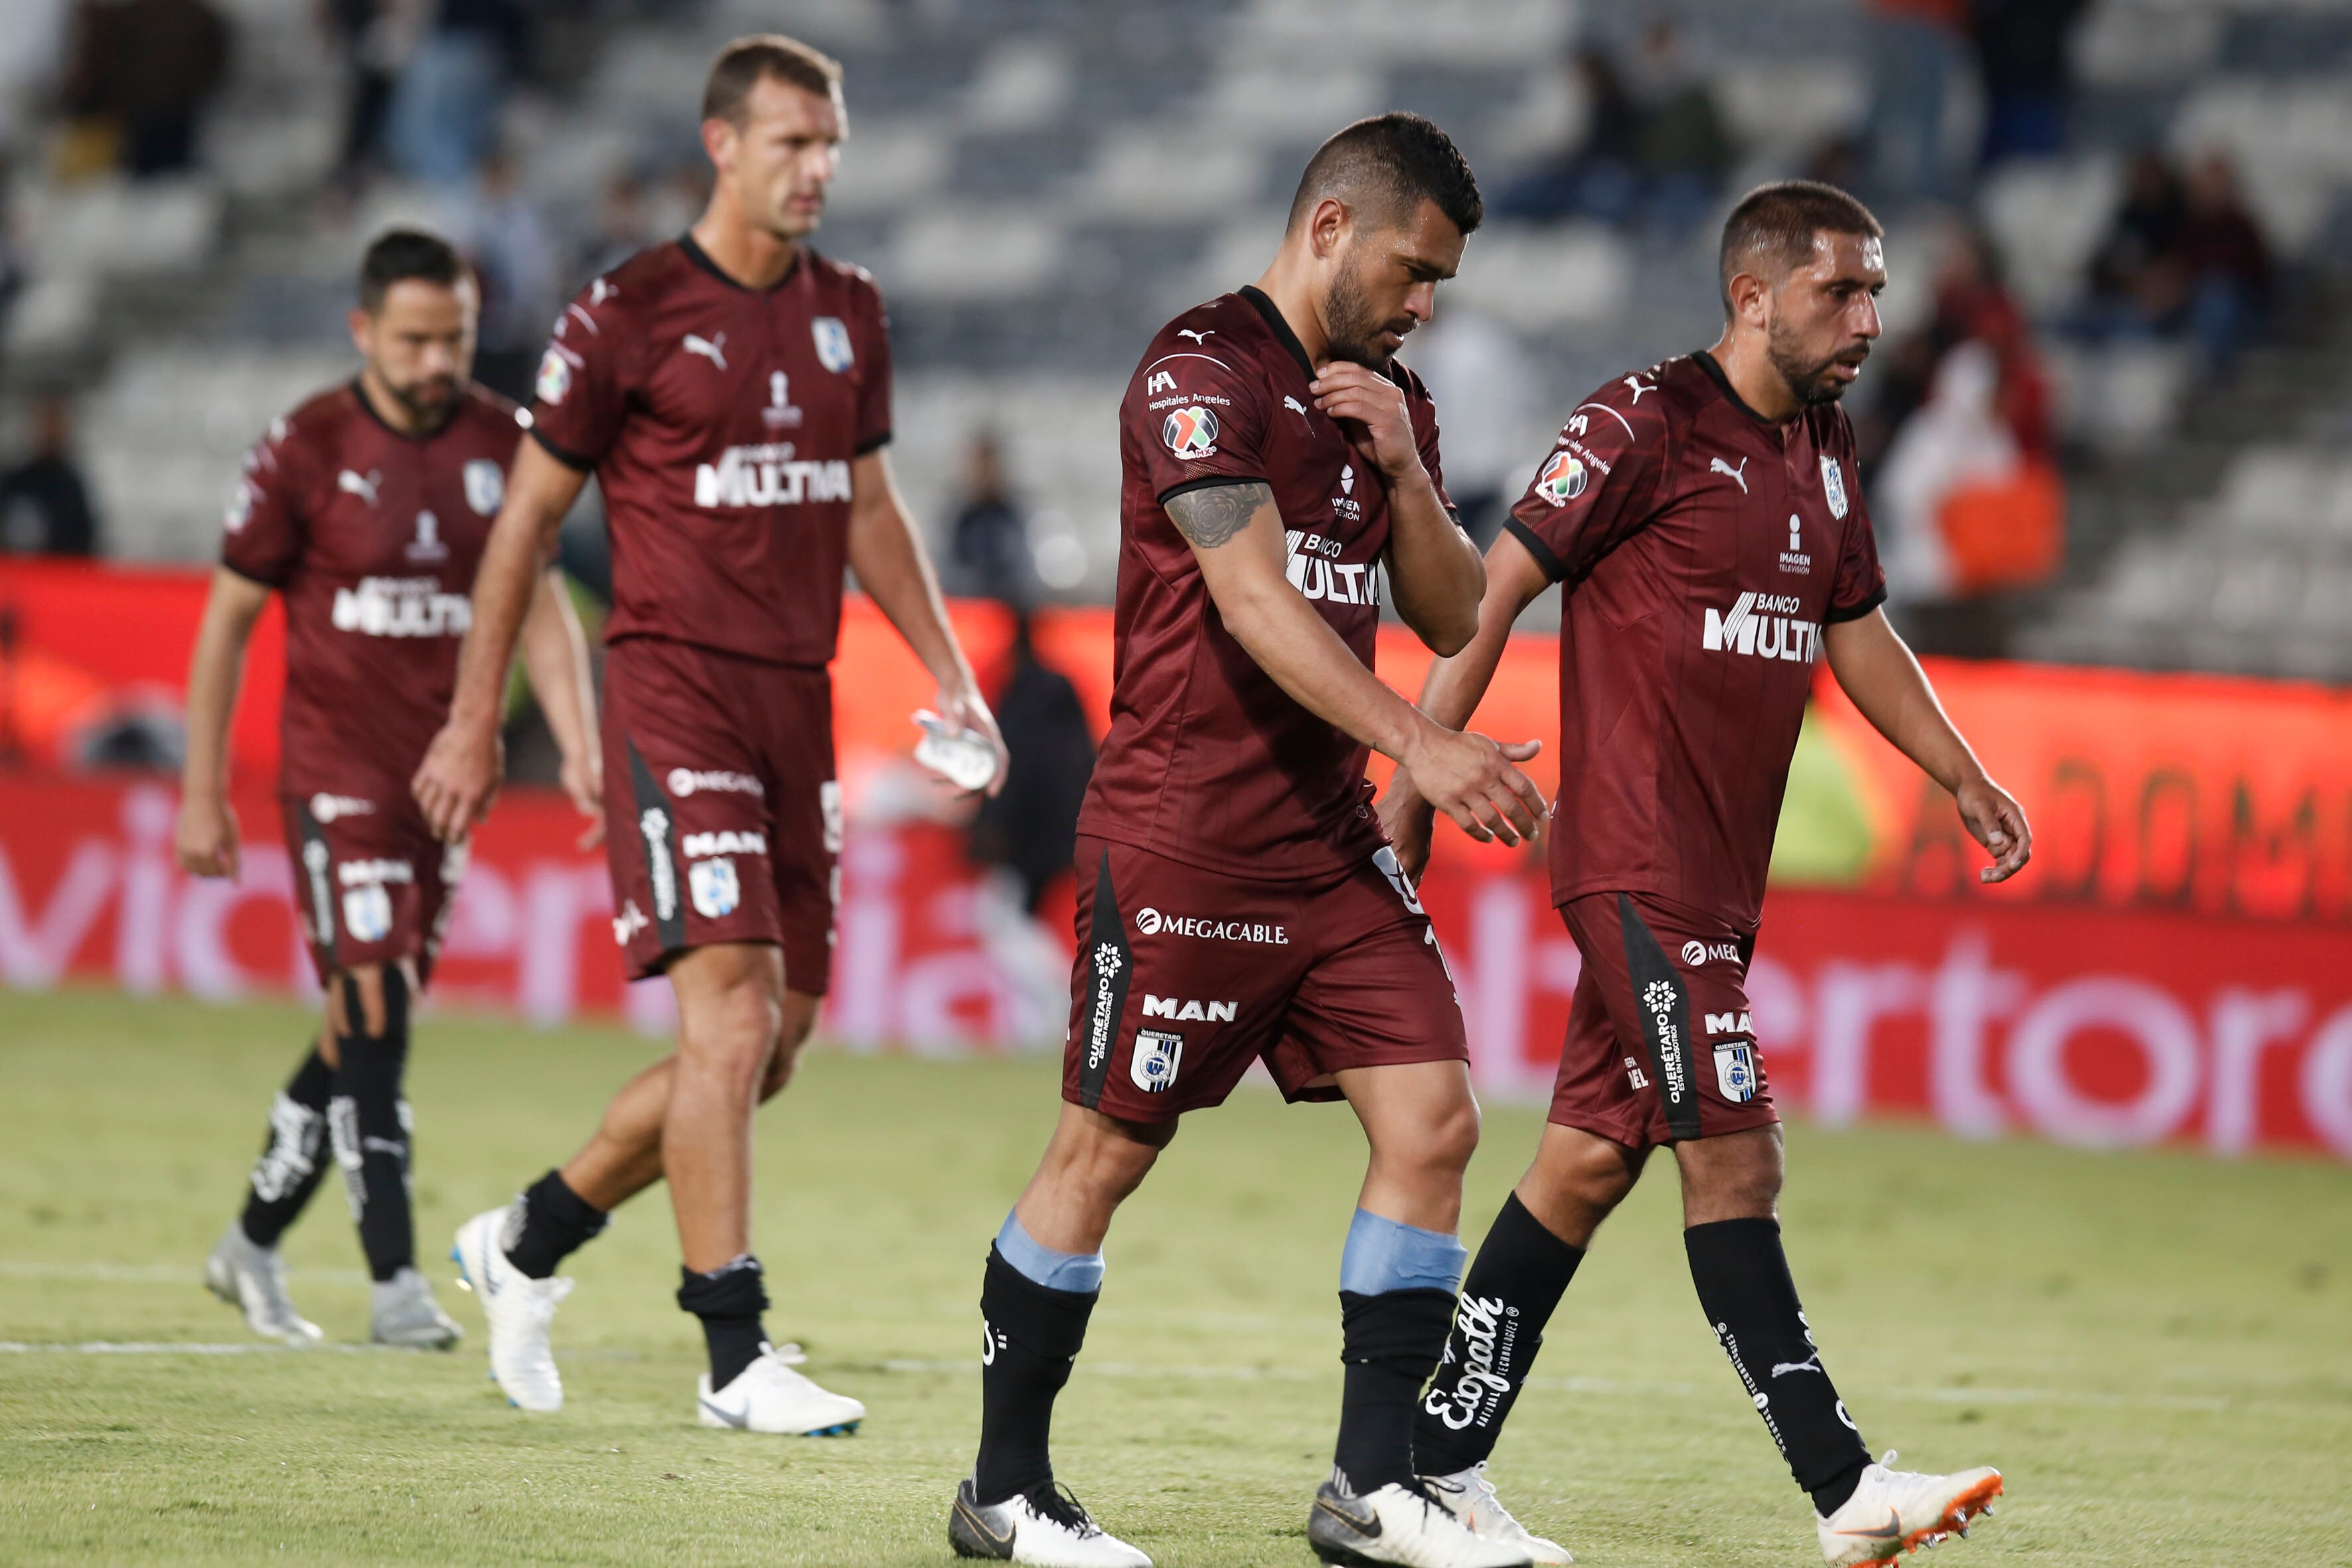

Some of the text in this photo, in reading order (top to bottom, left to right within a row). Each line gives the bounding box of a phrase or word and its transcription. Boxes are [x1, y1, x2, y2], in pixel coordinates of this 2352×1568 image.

[1148, 393, 1231, 412] Hospitales Angeles
[1582, 449, 1611, 475] Angeles
[1780, 552, 1811, 566] IMAGEN
[1757, 593, 1800, 613] BANCO
[682, 831, 766, 858] MAN
[1162, 915, 1285, 944] MEGACABLE
[1104, 992, 1114, 1031] NOSOTROS
[1142, 994, 1238, 1022] MAN
[1089, 977, 1109, 1069] QUERÉTARO
[1101, 1030, 1108, 1041] EN
[1140, 1029, 1181, 1041] QUERETARO
[1670, 1024, 1682, 1063] NOSOTROS
[1656, 1013, 1681, 1103] QUERÉTARO
[1676, 1063, 1684, 1073] EN
[1476, 1320, 1518, 1428] NATURAL TECHNOLOGIES
